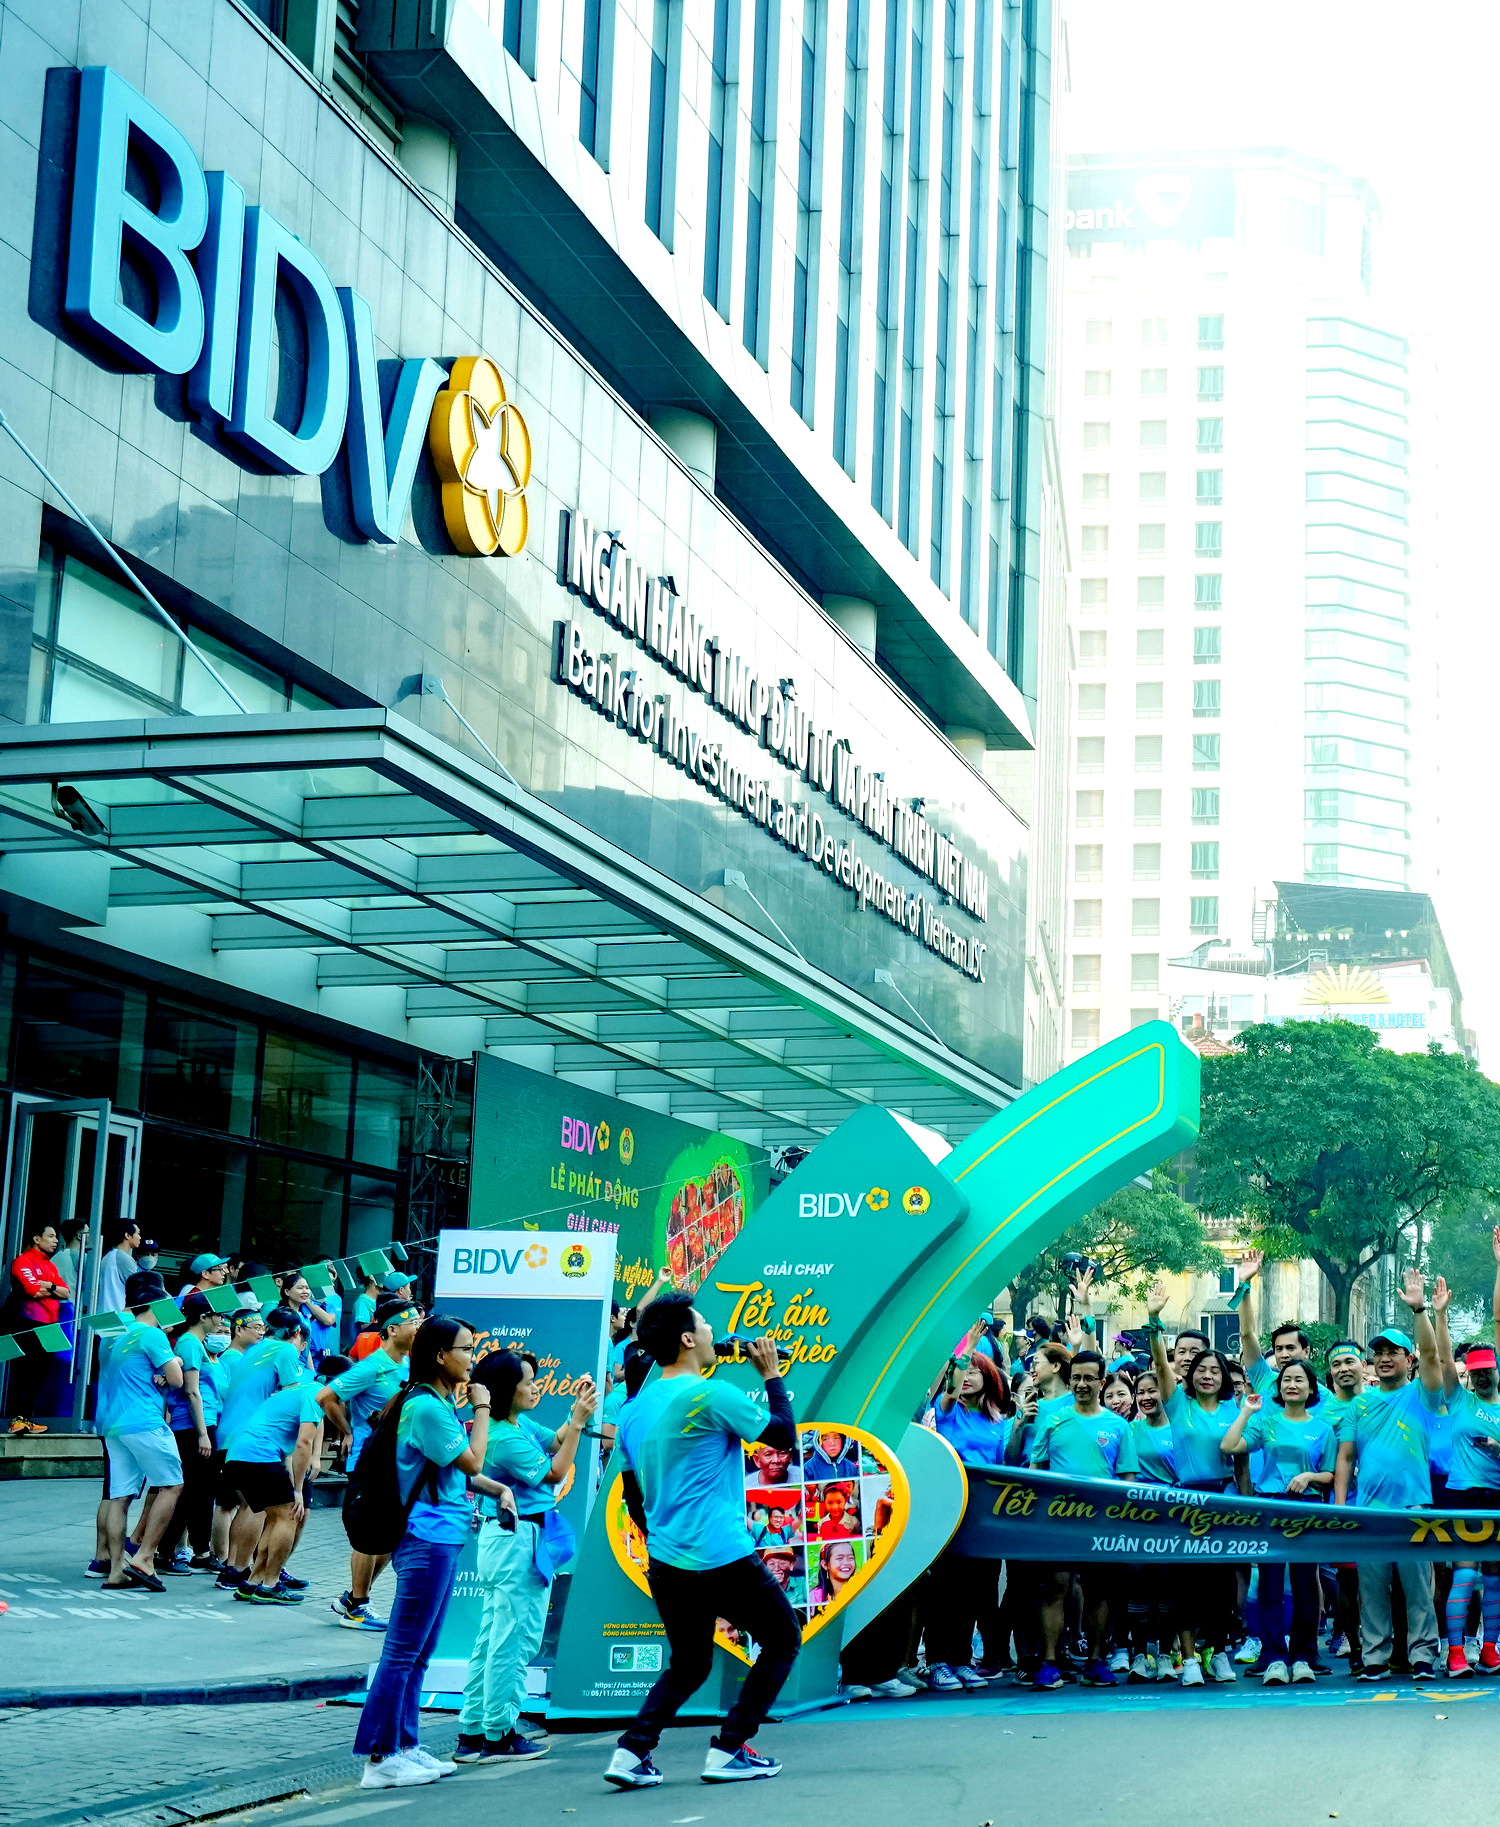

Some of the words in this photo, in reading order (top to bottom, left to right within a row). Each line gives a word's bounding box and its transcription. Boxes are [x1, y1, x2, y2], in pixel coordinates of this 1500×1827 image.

[66, 66, 449, 545] BIDV
[567, 509, 648, 641] NGÂN
[647, 576, 713, 693] HÀNG
[767, 679, 809, 771] ĐẦU
[855, 764, 895, 846] PHÁT
[894, 797, 935, 880] TRIỂN
[935, 833, 962, 905] VIỆT
[962, 857, 989, 923] NAM
[562, 620, 629, 722] Bank
[629, 671, 664, 745] for
[663, 694, 773, 827] Investment
[772, 802, 809, 852] and
[809, 811, 906, 927] Development
[905, 892, 922, 936] of
[922, 896, 968, 969] Vietnam
[967, 935, 987, 984] JSC
[561, 1115, 599, 1156] BIDV
[550, 1162, 566, 1191] LỄ
[568, 1170, 602, 1200] PHÁT
[604, 1177, 640, 1210] ĐỘNG
[799, 1192, 867, 1219] BIDV
[453, 1248, 525, 1275] BIDV
[763, 1262, 792, 1276] GIẢI
[794, 1263, 835, 1278] CHẠY
[715, 1280, 776, 1334] Tết
[782, 1287, 831, 1329] ấm
[491, 1324, 508, 1336] GIẢI
[509, 1327, 533, 1338] CHẠY
[764, 1322, 794, 1342] cho
[537, 1353, 563, 1369] cho
[1475, 1408, 1500, 1425] BIDV
[986, 1478, 1038, 1516] Tết
[1047, 1491, 1098, 1519] ấm
[1105, 1500, 1160, 1523] cho
[1168, 1503, 1261, 1536] Người
[1270, 1510, 1361, 1538] nghèo
[1091, 1534, 1140, 1552] XUÂN
[1143, 1535, 1181, 1554] QUÝ
[1183, 1537, 1224, 1555] MÃO
[1226, 1540, 1270, 1555] 2023
